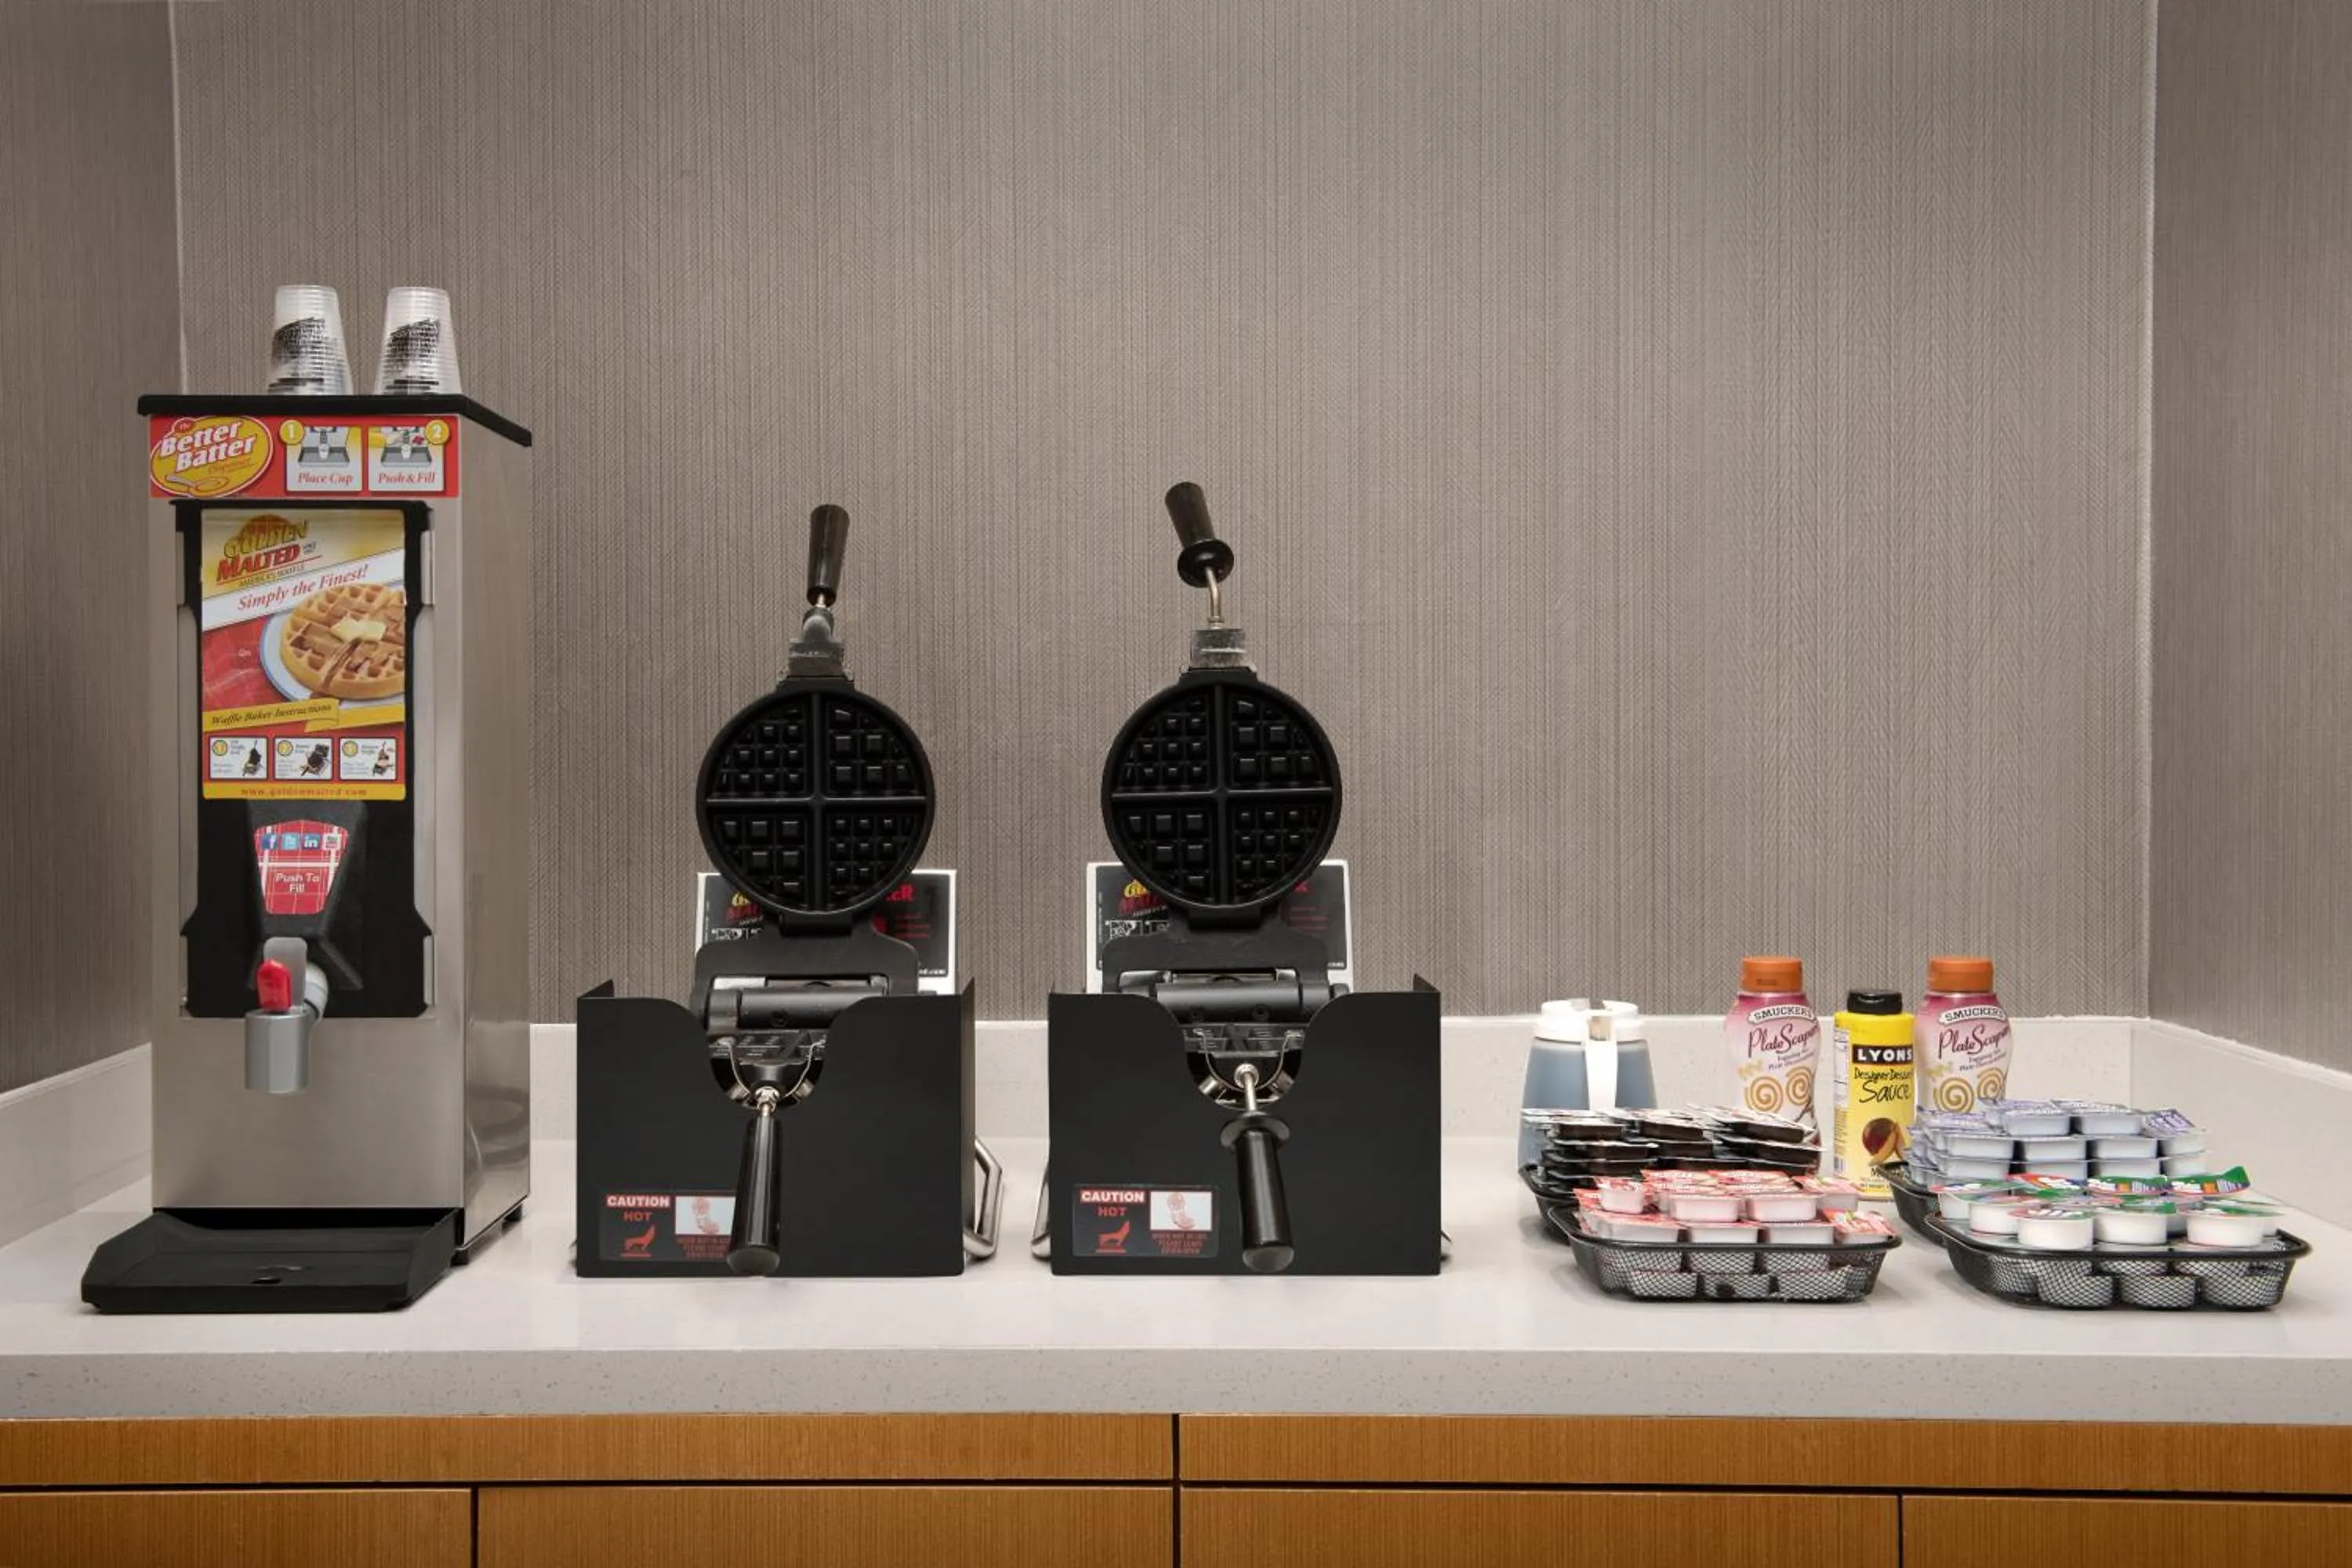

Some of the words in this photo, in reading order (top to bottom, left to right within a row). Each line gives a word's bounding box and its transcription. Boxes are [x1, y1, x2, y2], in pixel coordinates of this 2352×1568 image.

[160, 419, 244, 457] Better
[286, 424, 296, 439] 1
[432, 425, 442, 439] 2
[175, 433, 257, 473] Batter
[297, 472, 327, 485] Place
[329, 472, 354, 485] Cup
[378, 472, 401, 485] Push
[416, 472, 436, 485] Fill
[216, 543, 302, 582] MALTED
[238, 587, 289, 611] Simply
[292, 579, 314, 597] the
[319, 564, 368, 590] Finest!
[275, 873, 303, 883] Push
[305, 873, 321, 883] To
[289, 883, 305, 894] Fill
[1857, 1048, 1913, 1062] LYONS
[1854, 1065, 1889, 1083] Designer
[1858, 1079, 1911, 1103] Sauce
[605, 1194, 670, 1208] CAUTION
[1080, 1190, 1145, 1203] CAUTION
[623, 1210, 653, 1222] HOT
[1098, 1207, 1127, 1217] HOT
